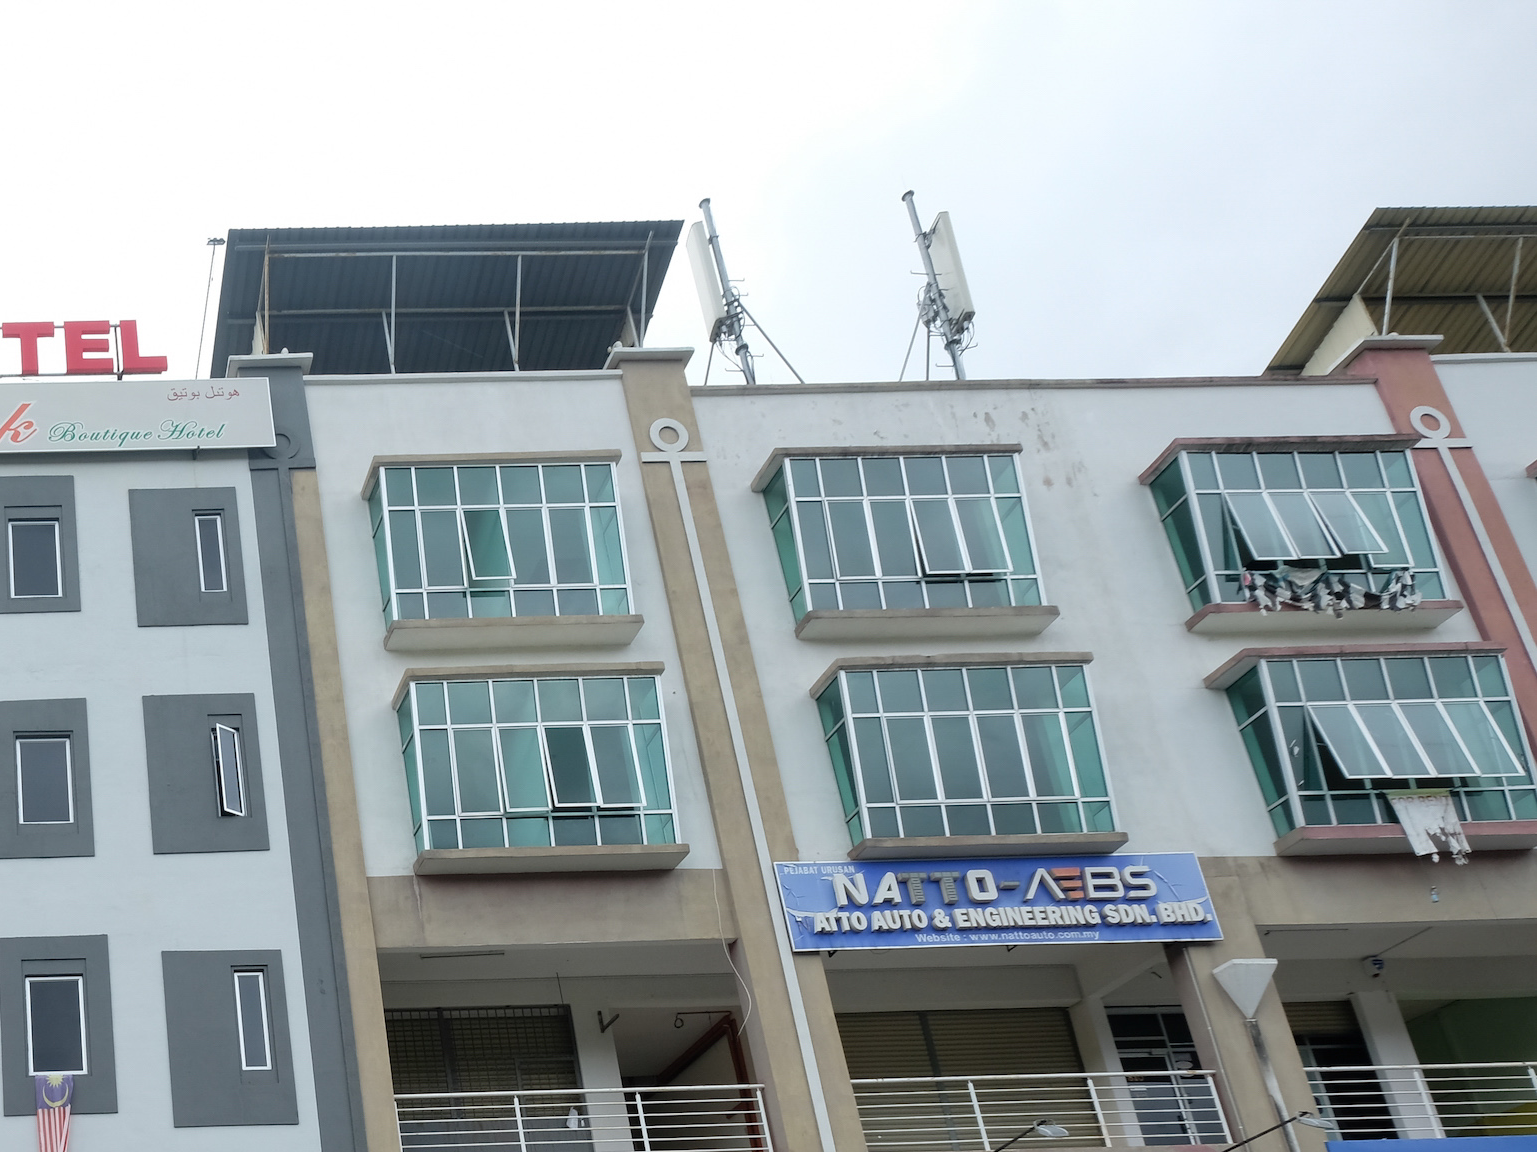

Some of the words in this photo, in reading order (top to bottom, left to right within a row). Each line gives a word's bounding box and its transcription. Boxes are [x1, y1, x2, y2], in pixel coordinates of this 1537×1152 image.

[48, 421, 153, 447] Boutique
[157, 419, 227, 440] Hotel
[784, 865, 819, 875] PEJABAT
[821, 865, 855, 874] URUSAN
[871, 906, 928, 930] AUTO
[931, 908, 952, 930] &
[952, 904, 1102, 930] ENGINEERING
[1101, 902, 1157, 926] SDN.
[1157, 901, 1213, 924] BHD.
[915, 933, 960, 942] Website
[969, 931, 1100, 942] www.nattoauto.com.my
